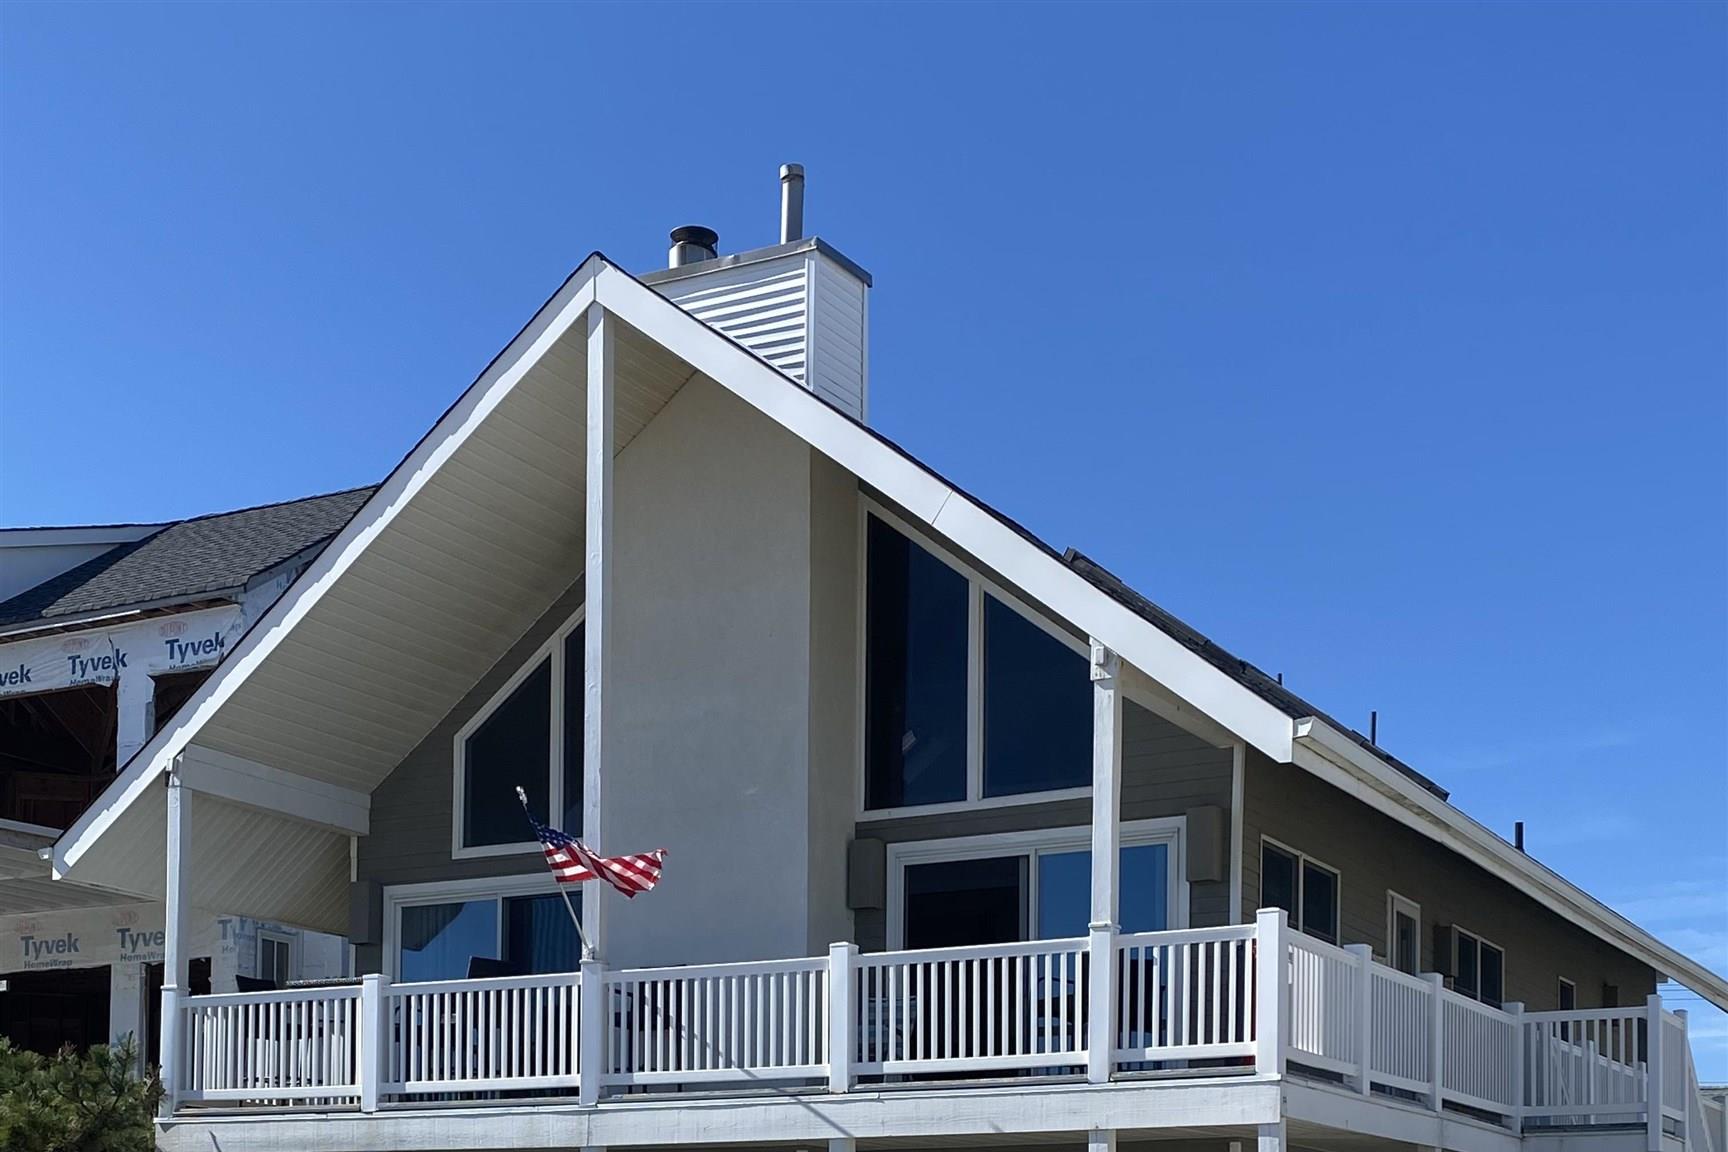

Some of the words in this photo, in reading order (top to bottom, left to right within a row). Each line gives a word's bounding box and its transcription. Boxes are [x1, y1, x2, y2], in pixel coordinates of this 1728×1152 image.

[165, 632, 224, 663] Tyvek
[68, 648, 128, 678] Tyvek
[21, 932, 79, 960] Tyvek
[117, 927, 166, 953] Tyve
